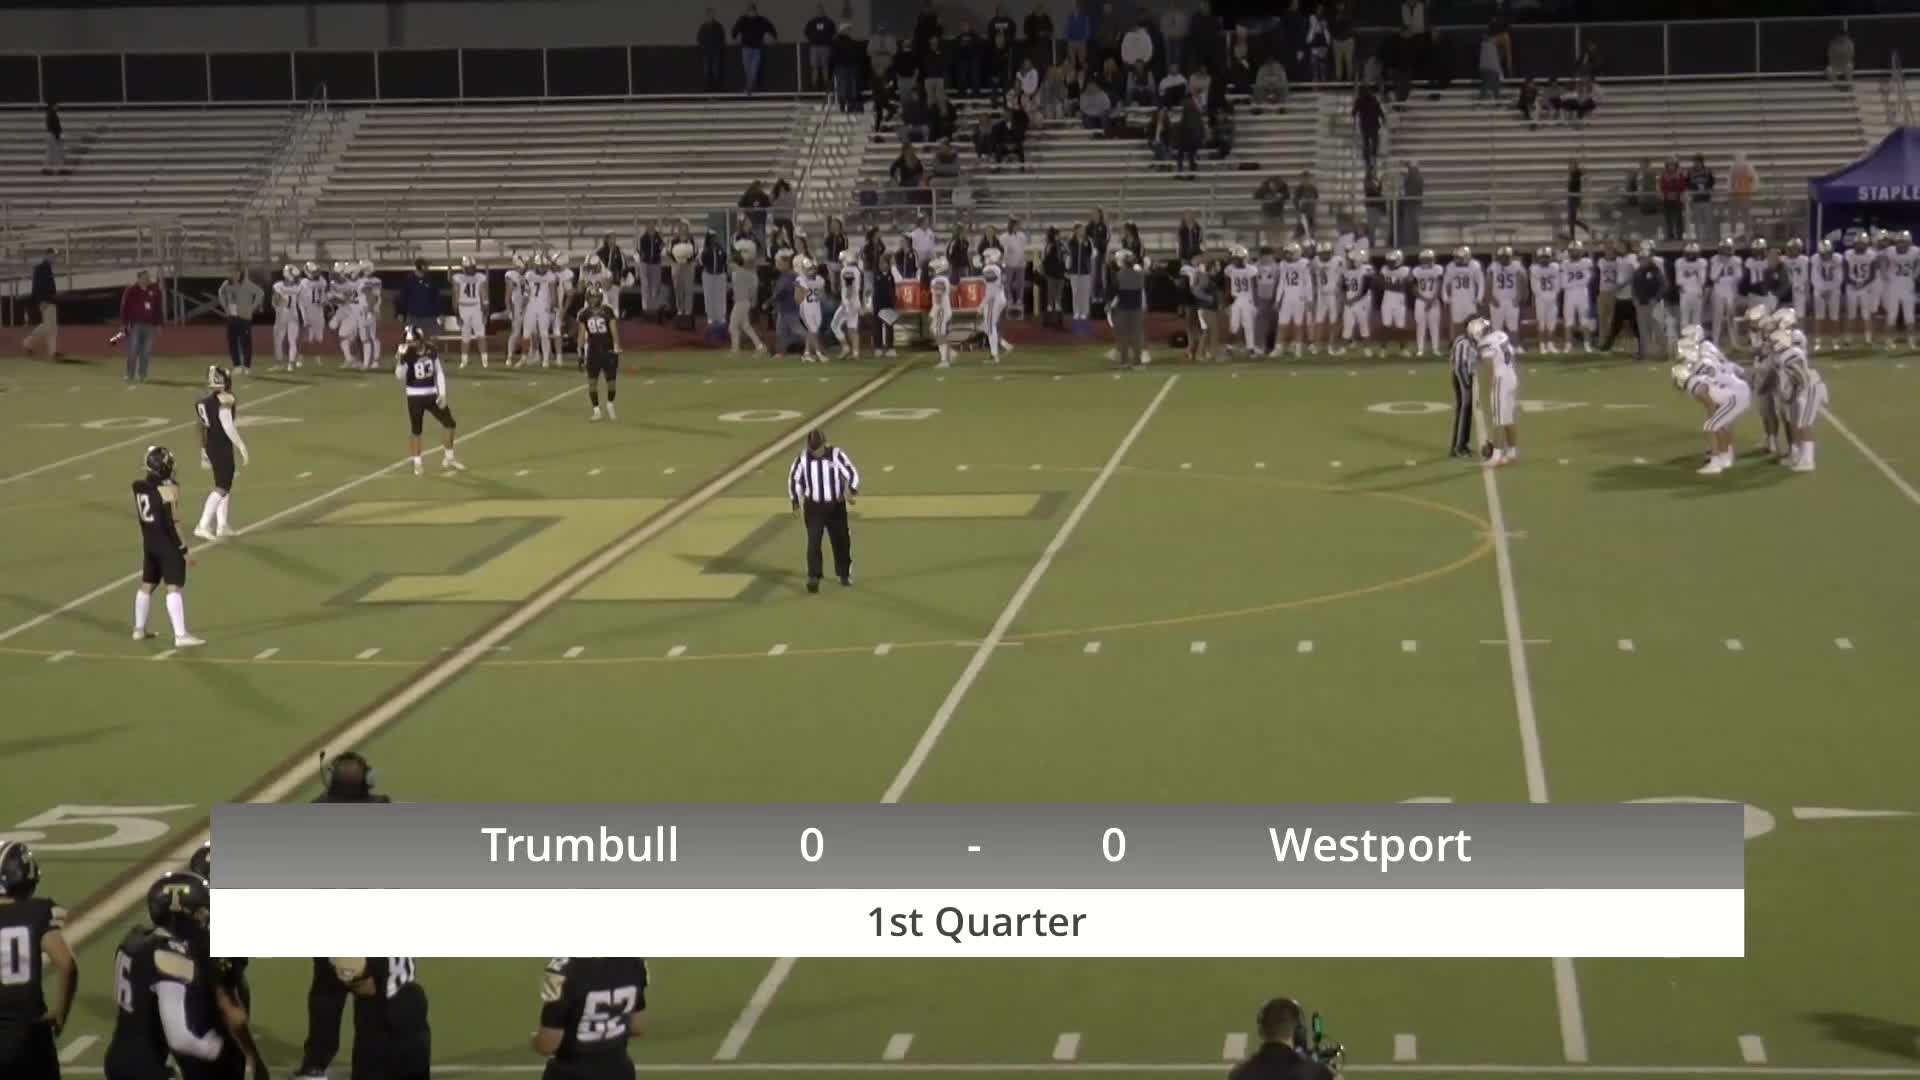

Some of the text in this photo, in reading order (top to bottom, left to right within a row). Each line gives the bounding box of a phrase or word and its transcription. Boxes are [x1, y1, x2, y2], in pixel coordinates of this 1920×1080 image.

[1234, 277, 1249, 292] 99
[1497, 273, 1513, 289] 95
[464, 283, 476, 298] 41
[414, 358, 434, 379] 83
[136, 493, 155, 522] 12
